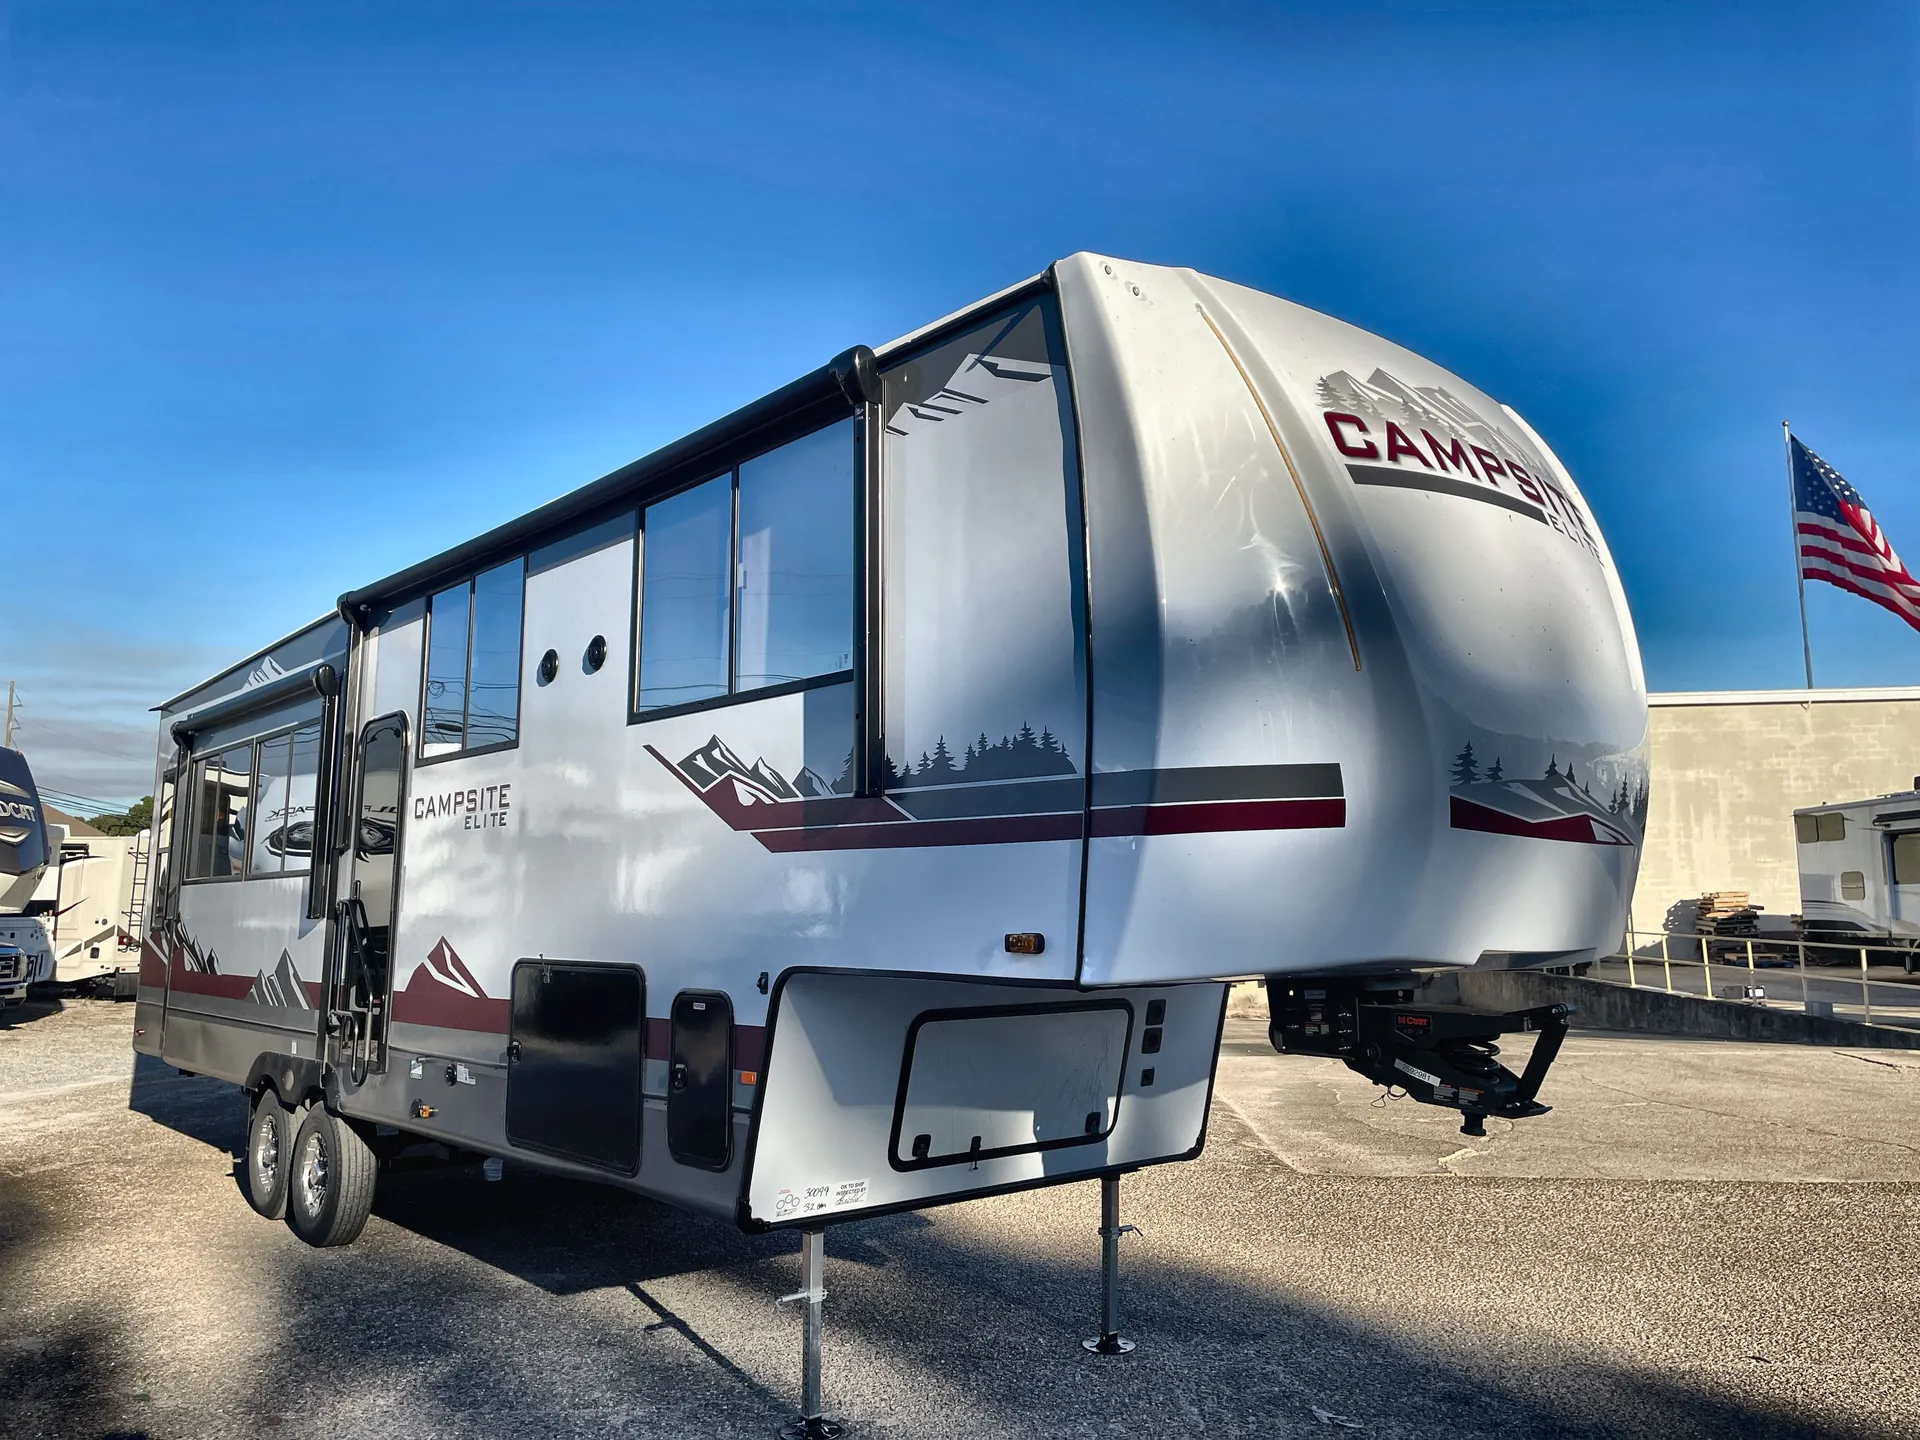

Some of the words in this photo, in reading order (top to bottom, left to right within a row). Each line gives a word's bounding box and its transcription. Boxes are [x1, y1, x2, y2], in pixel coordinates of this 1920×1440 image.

[1323, 411, 1599, 548] CAMPSITE
[1547, 512, 1604, 567] ELITE
[414, 783, 511, 819] CAMPSITE
[464, 811, 508, 830] ELITE
